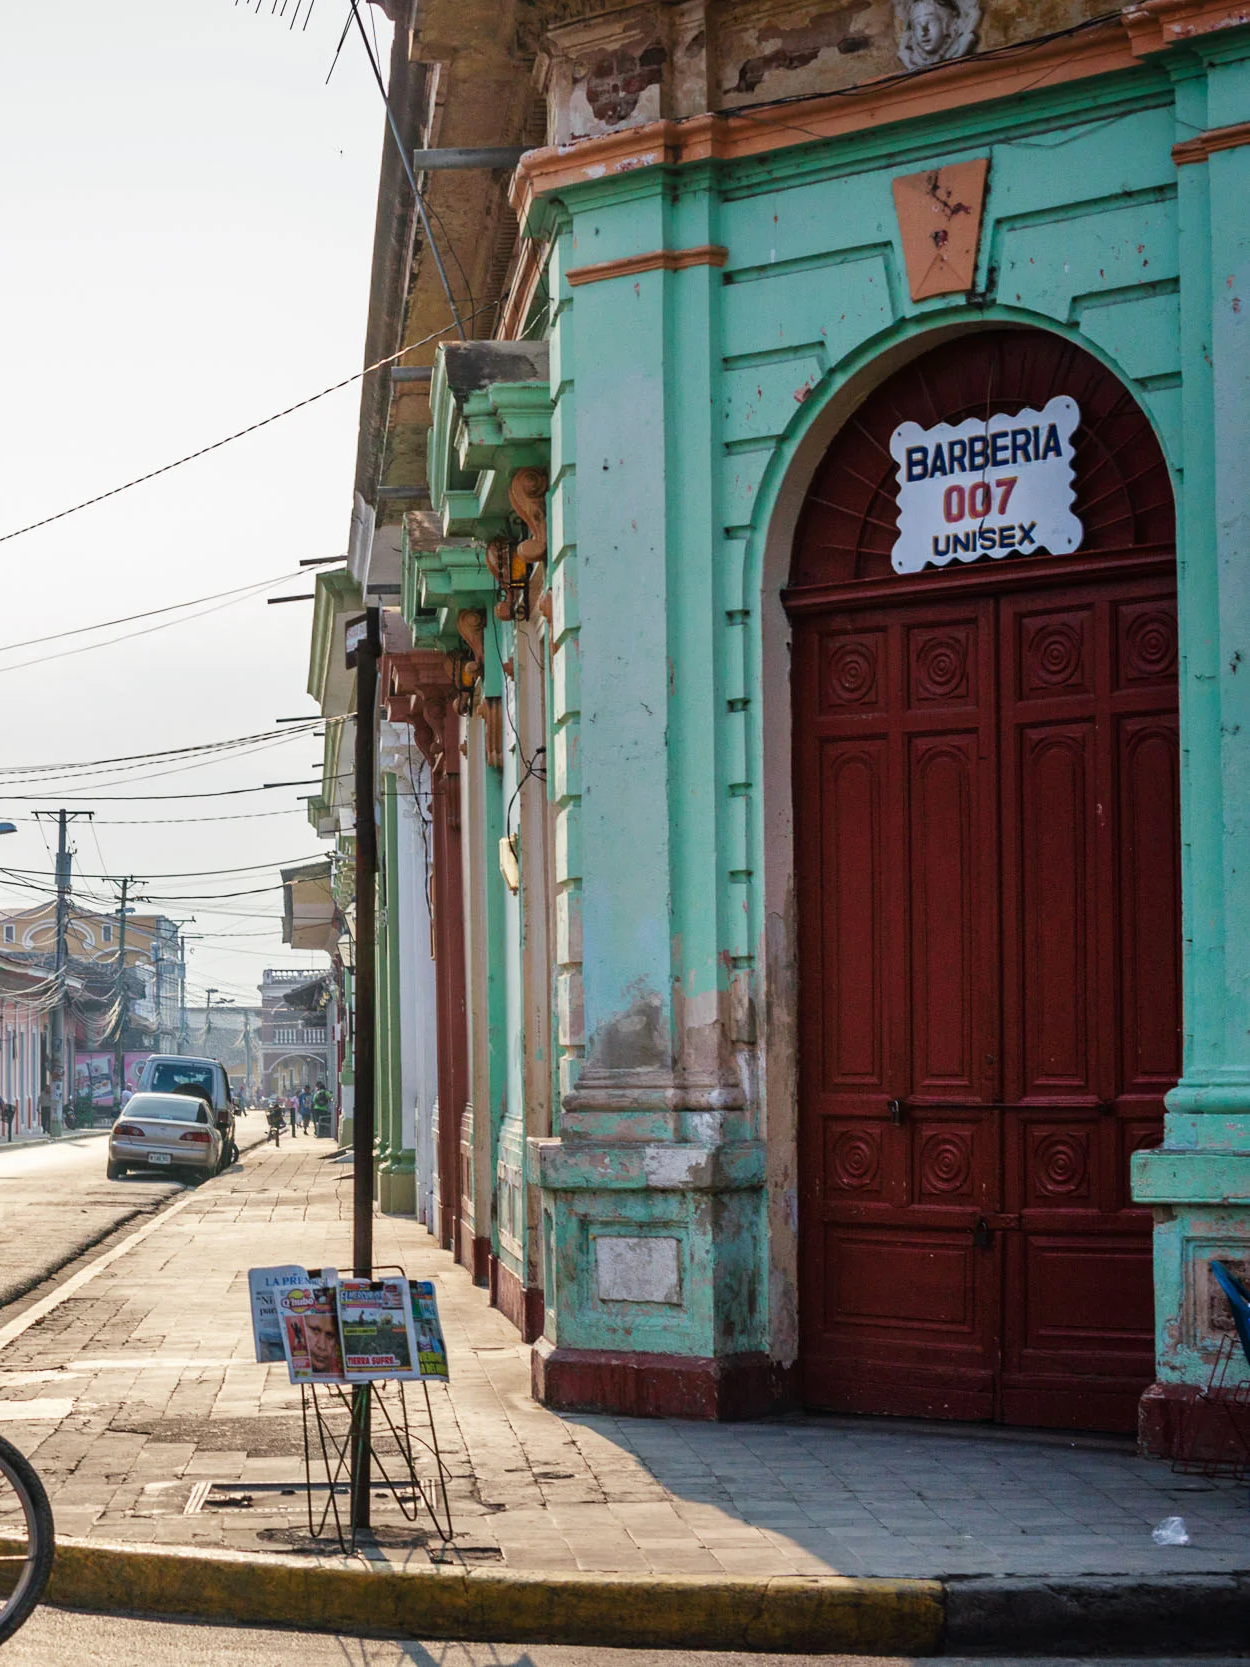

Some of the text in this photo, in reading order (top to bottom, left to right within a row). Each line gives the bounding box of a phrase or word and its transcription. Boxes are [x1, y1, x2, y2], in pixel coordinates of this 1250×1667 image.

[905, 422, 1063, 483] BARBERIA
[943, 475, 1019, 524] 007
[932, 520, 1038, 557] UNISEX
[265, 1277, 280, 1287] LA
